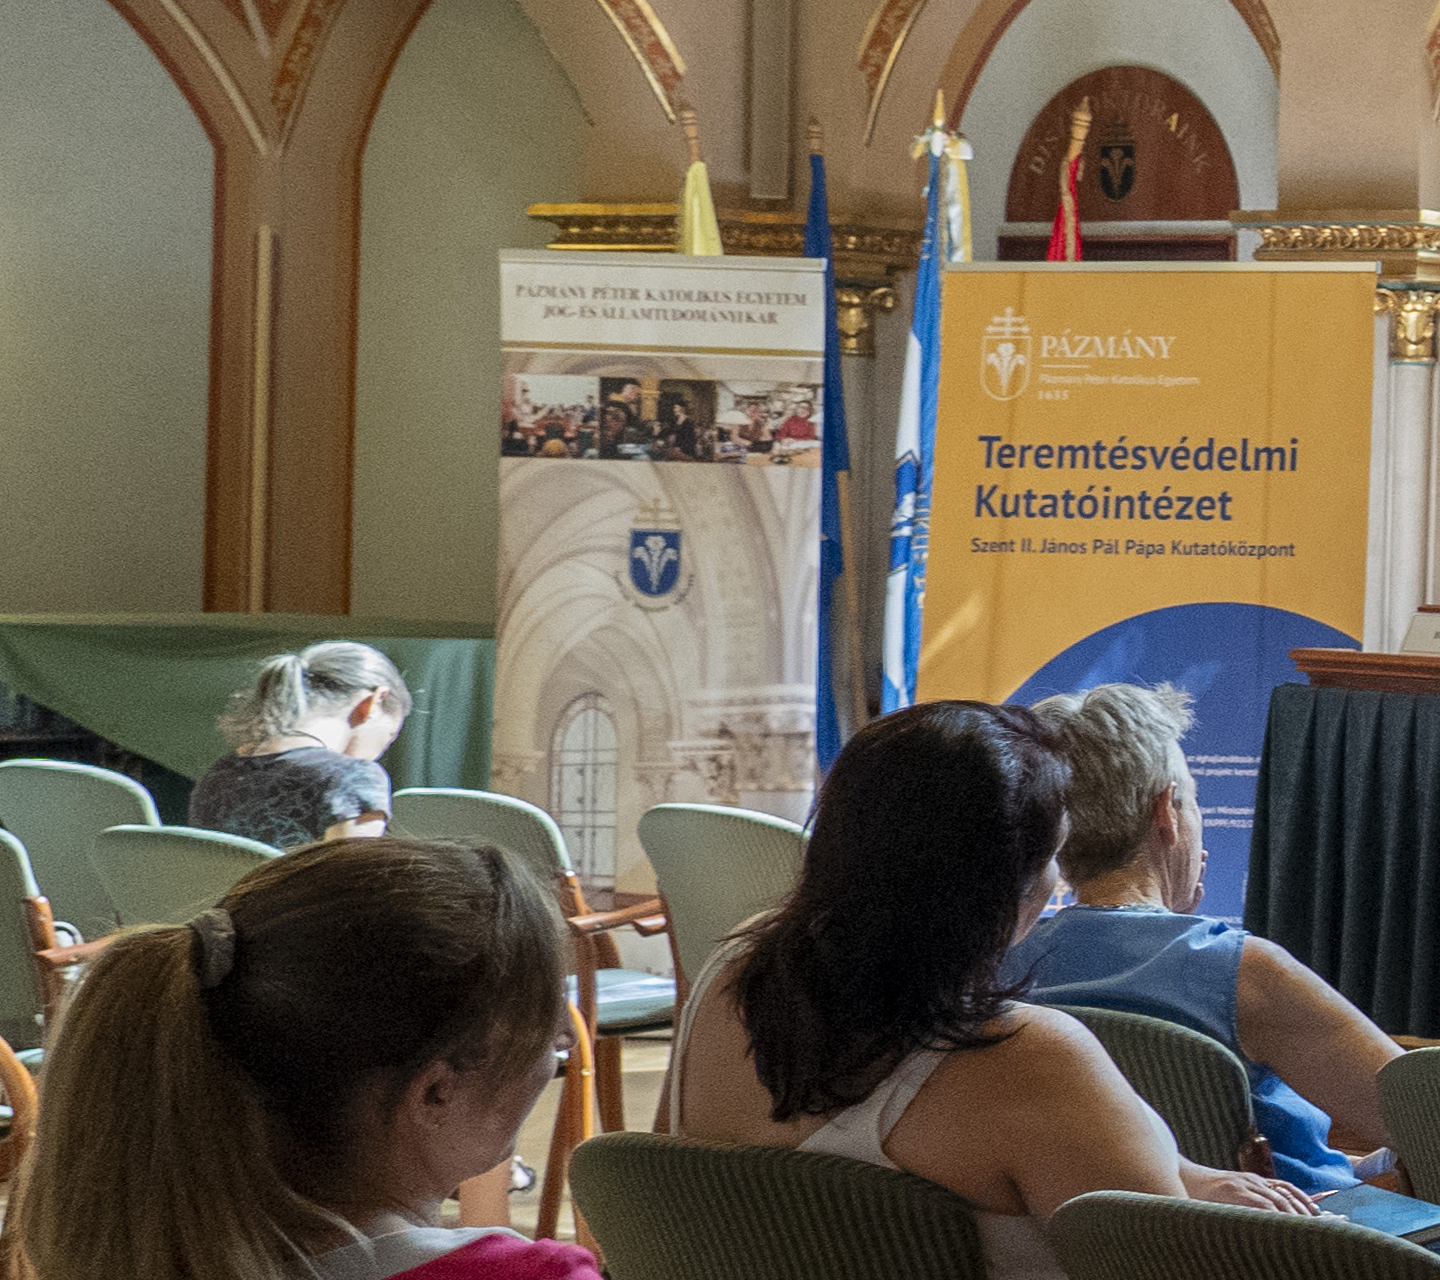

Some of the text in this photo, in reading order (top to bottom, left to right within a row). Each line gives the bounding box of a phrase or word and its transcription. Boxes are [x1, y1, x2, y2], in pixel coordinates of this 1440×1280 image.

[591, 284, 640, 301] PÉTER
[644, 288, 732, 304] KATOLIKUS
[736, 290, 808, 306] EGYETEM
[1040, 328, 1177, 359] PÁZMÁNY
[978, 435, 1299, 472] Teremtésvédelmi
[974, 484, 1233, 521] Kutatóintézet
[970, 537, 1295, 560] Szent II. János Pál Pápa Kutatóközpont
